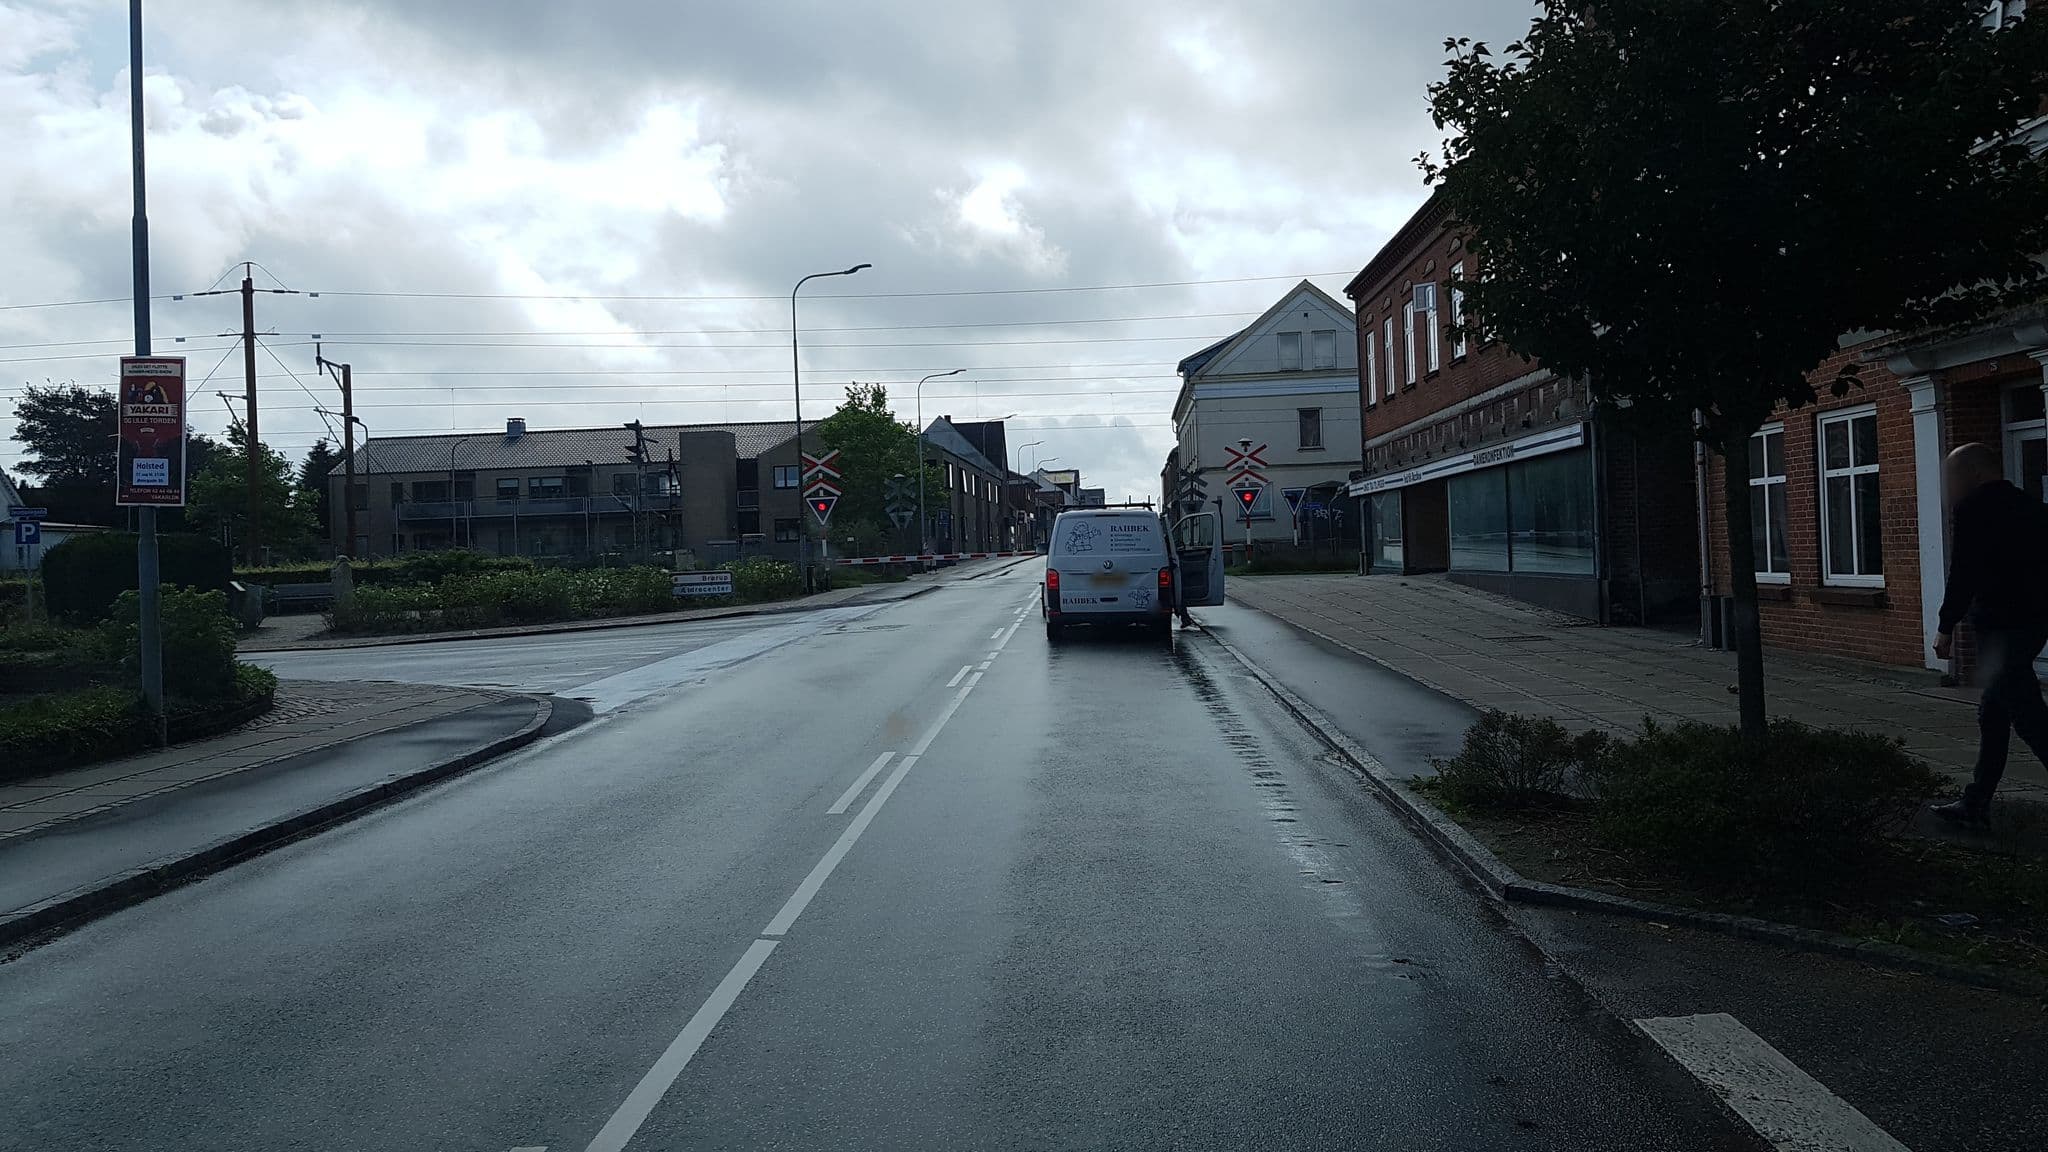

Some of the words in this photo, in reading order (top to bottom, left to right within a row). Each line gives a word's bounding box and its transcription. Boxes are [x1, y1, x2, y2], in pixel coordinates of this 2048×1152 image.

[130, 406, 169, 414] YAKARI
[136, 462, 165, 470] Holsted
[21, 523, 36, 542] P
[1062, 597, 1098, 605] RAHBEK
